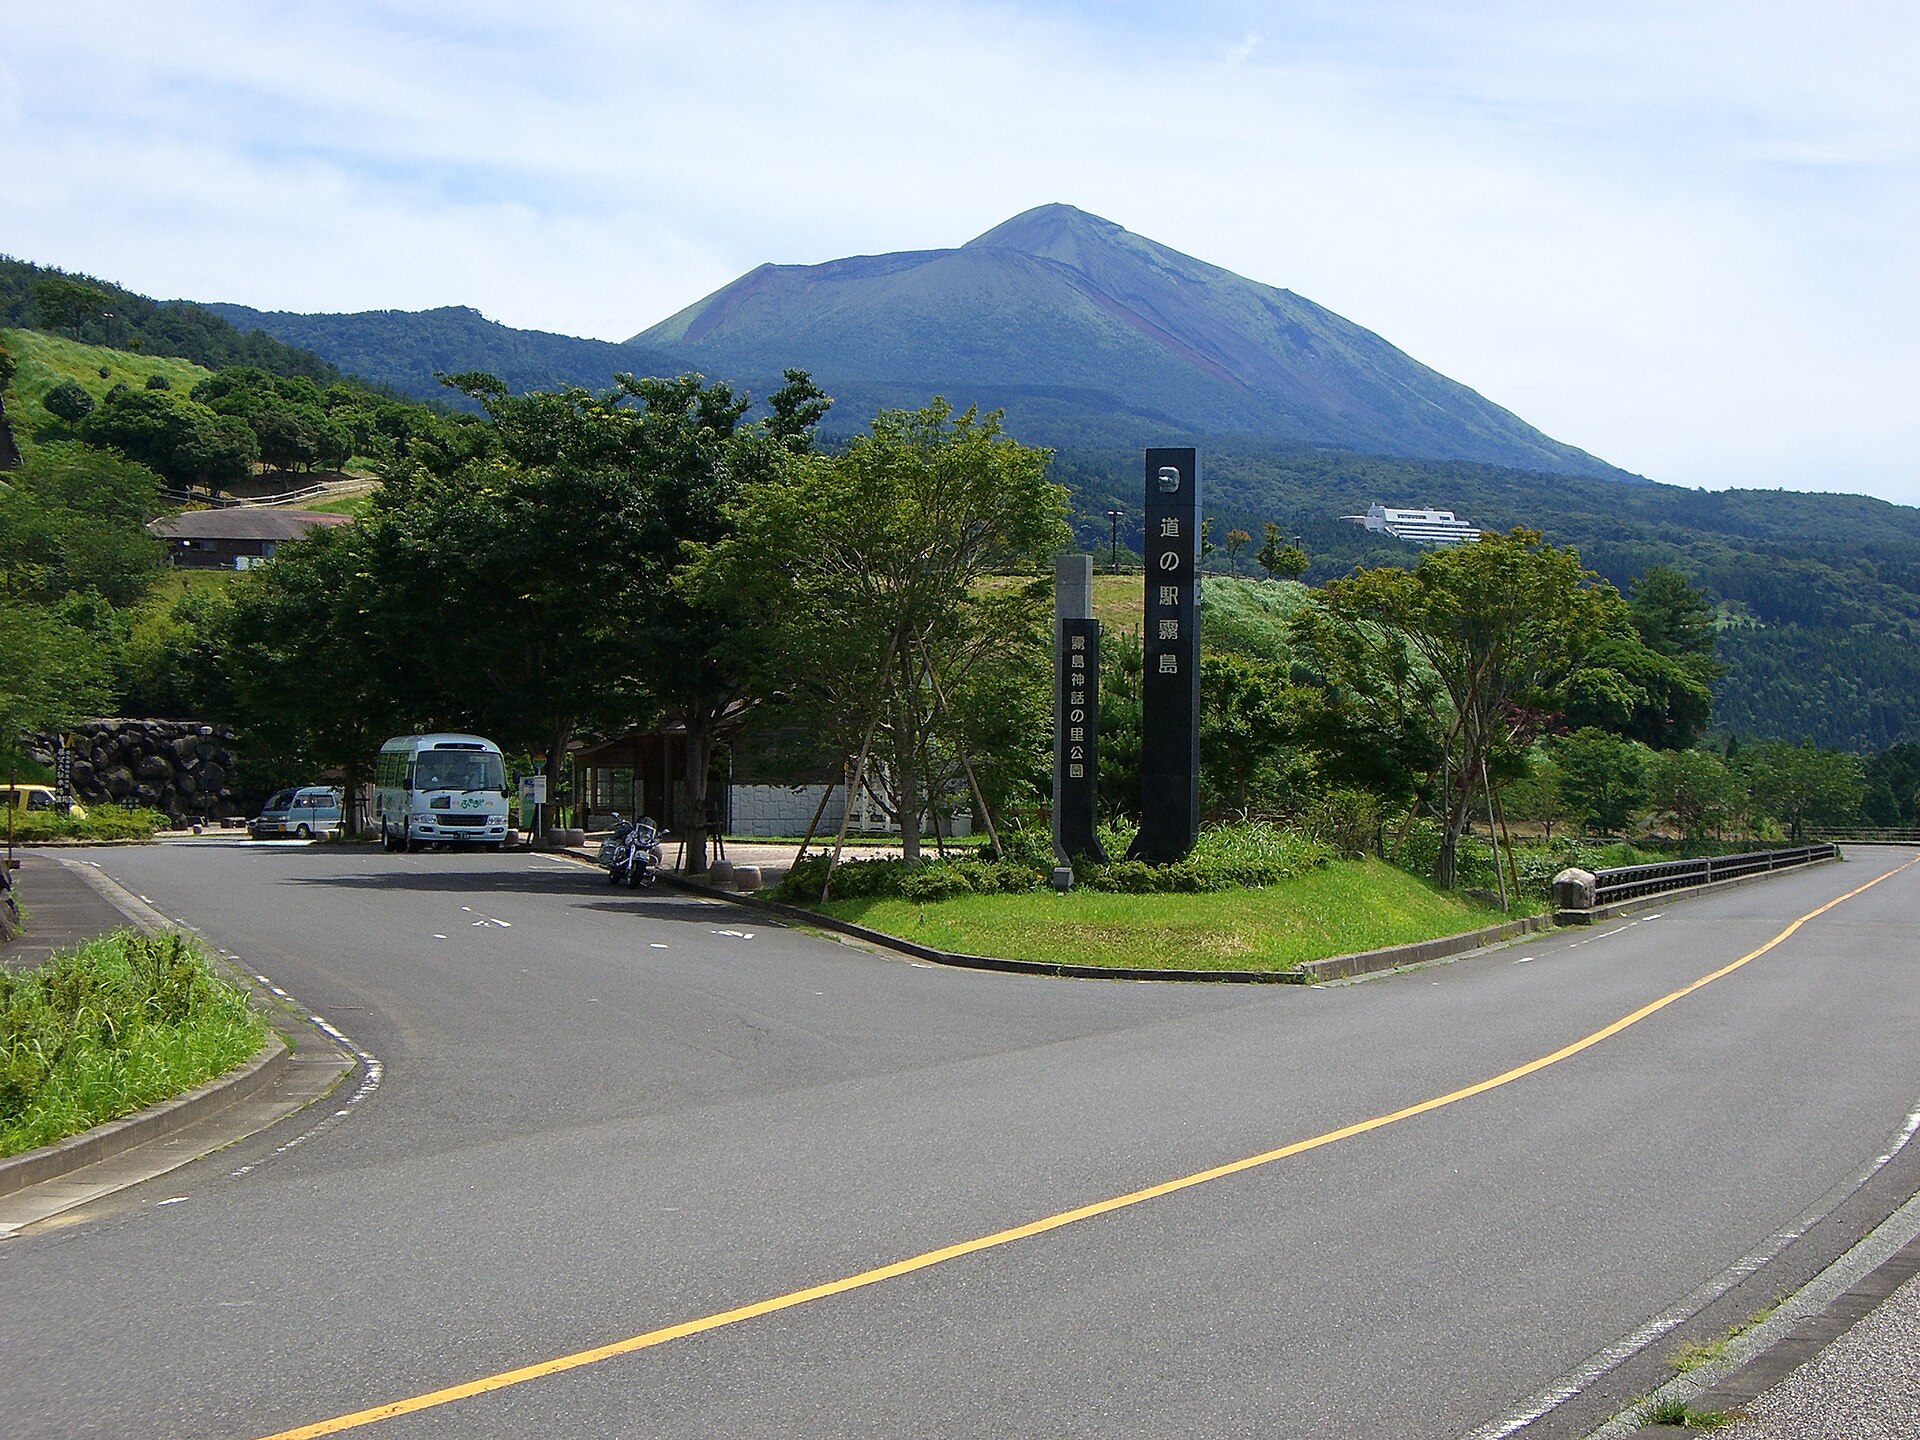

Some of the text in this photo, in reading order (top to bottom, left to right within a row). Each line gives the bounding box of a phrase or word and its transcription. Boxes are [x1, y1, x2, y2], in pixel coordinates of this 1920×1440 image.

[1159, 517, 1180, 675] 道の駅霧島
[1069, 635, 1085, 778] 霧島神話の里公園
